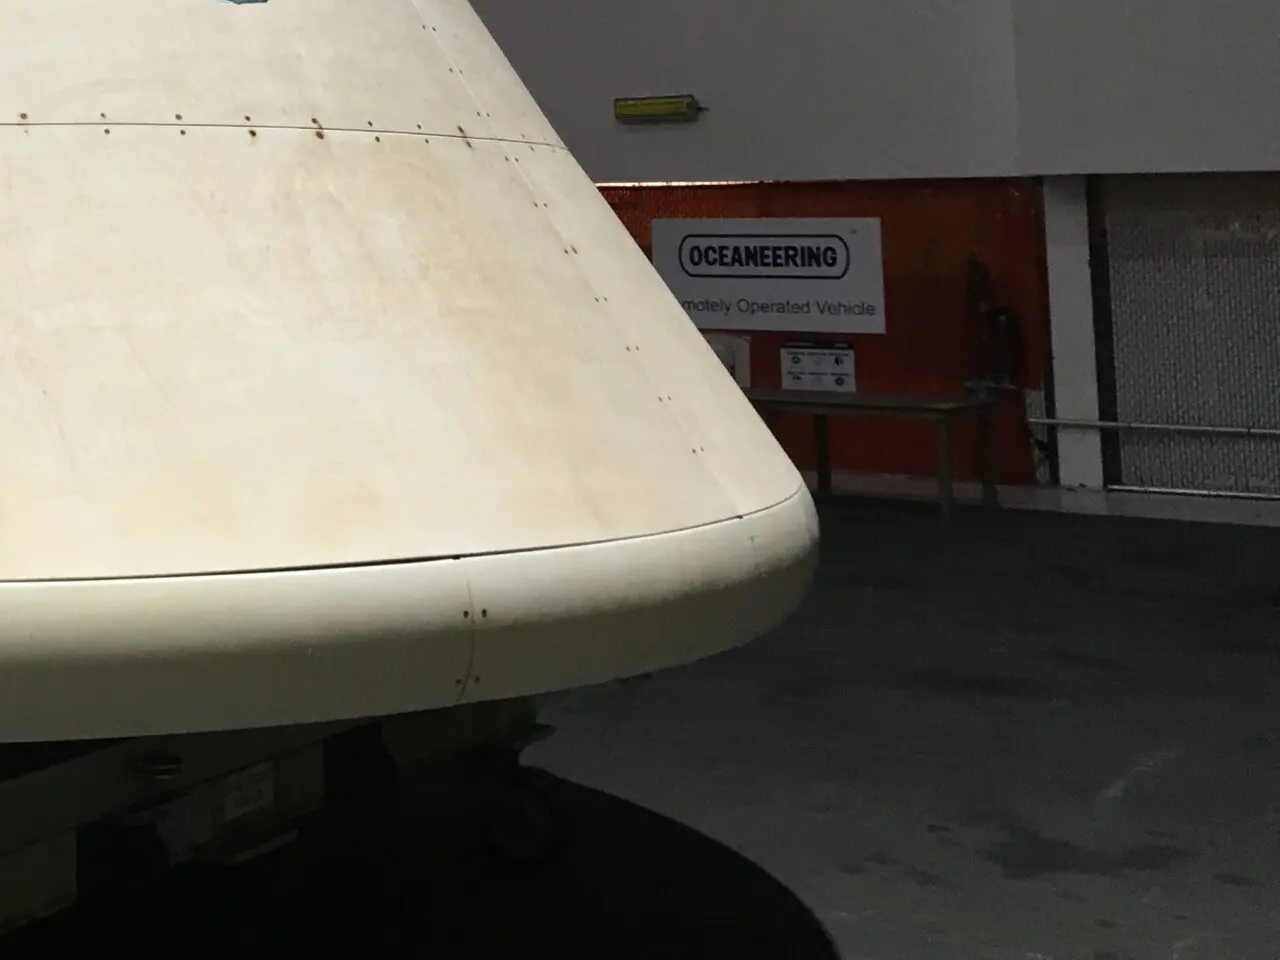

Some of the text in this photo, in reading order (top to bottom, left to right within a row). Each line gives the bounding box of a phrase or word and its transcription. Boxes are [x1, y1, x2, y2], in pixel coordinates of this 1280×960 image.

[688, 245, 839, 269] OCEANEERING
[682, 297, 877, 317] motely Operated Vehicle
